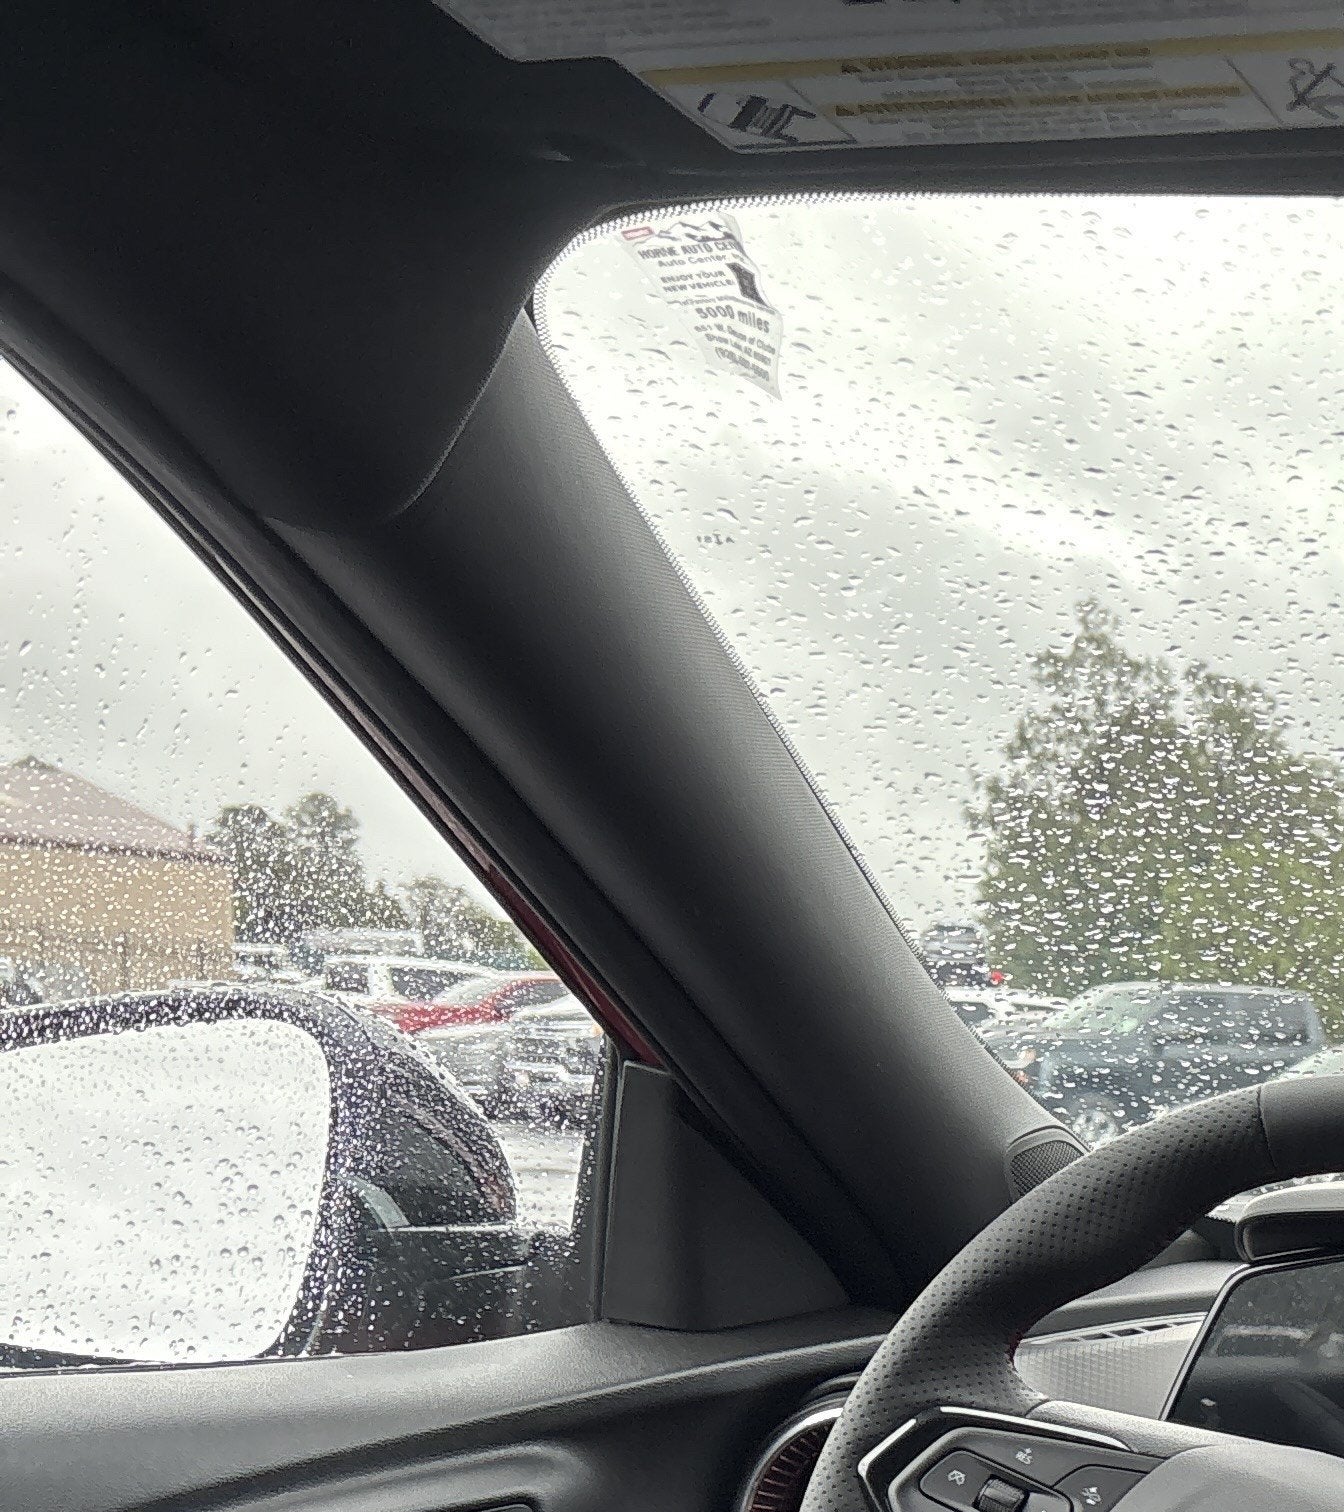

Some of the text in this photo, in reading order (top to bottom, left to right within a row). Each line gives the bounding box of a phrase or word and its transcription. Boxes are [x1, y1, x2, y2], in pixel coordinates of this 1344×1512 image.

[638, 246, 680, 260] HORNE
[681, 242, 713, 255] AUTO
[688, 255, 727, 264] Center
[660, 270, 726, 283] ENJOY YOUR
[662, 284, 688, 293] NEW
[695, 304, 735, 319] 5000
[737, 311, 770, 333] miles
